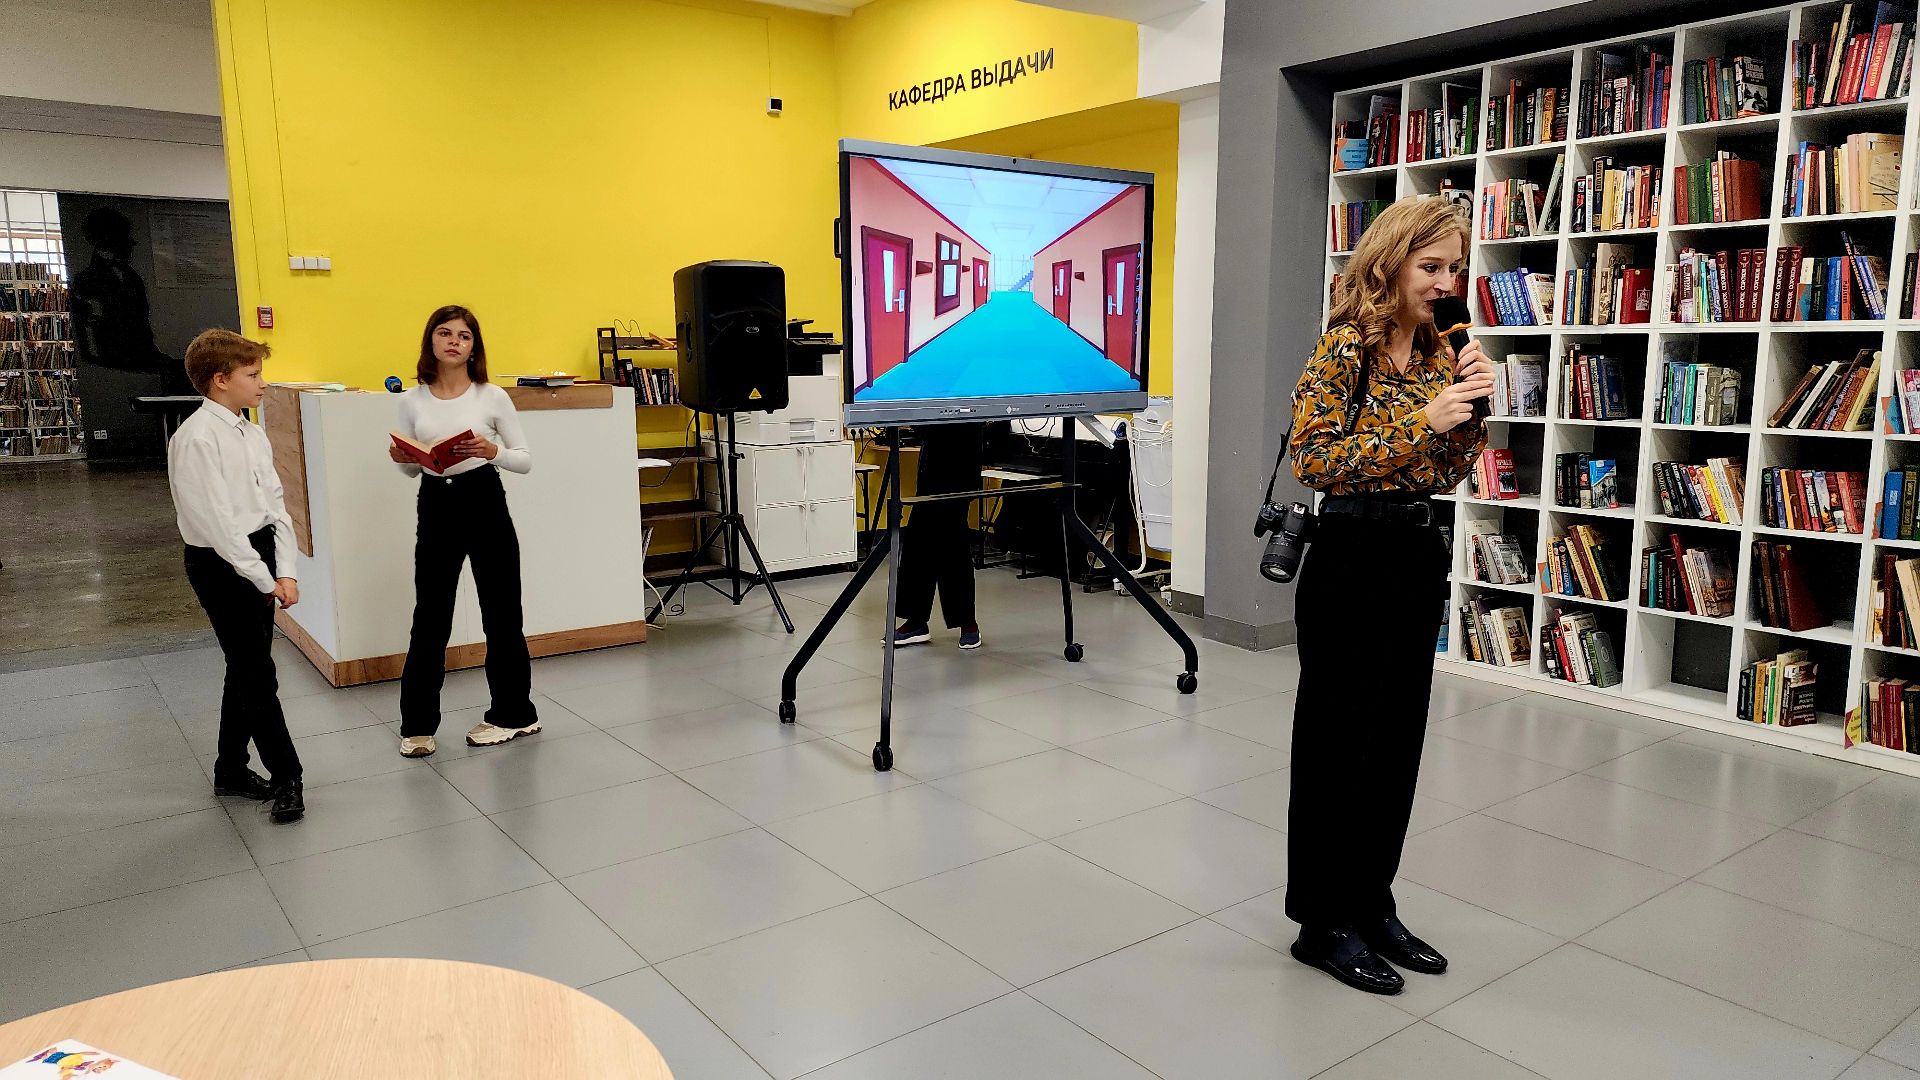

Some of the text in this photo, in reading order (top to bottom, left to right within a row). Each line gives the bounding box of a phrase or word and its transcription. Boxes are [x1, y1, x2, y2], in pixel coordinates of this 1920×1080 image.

[888, 47, 1054, 111] КАФЕДРА ВЫДАЧИ
[1345, 404, 1359, 431] Canon
